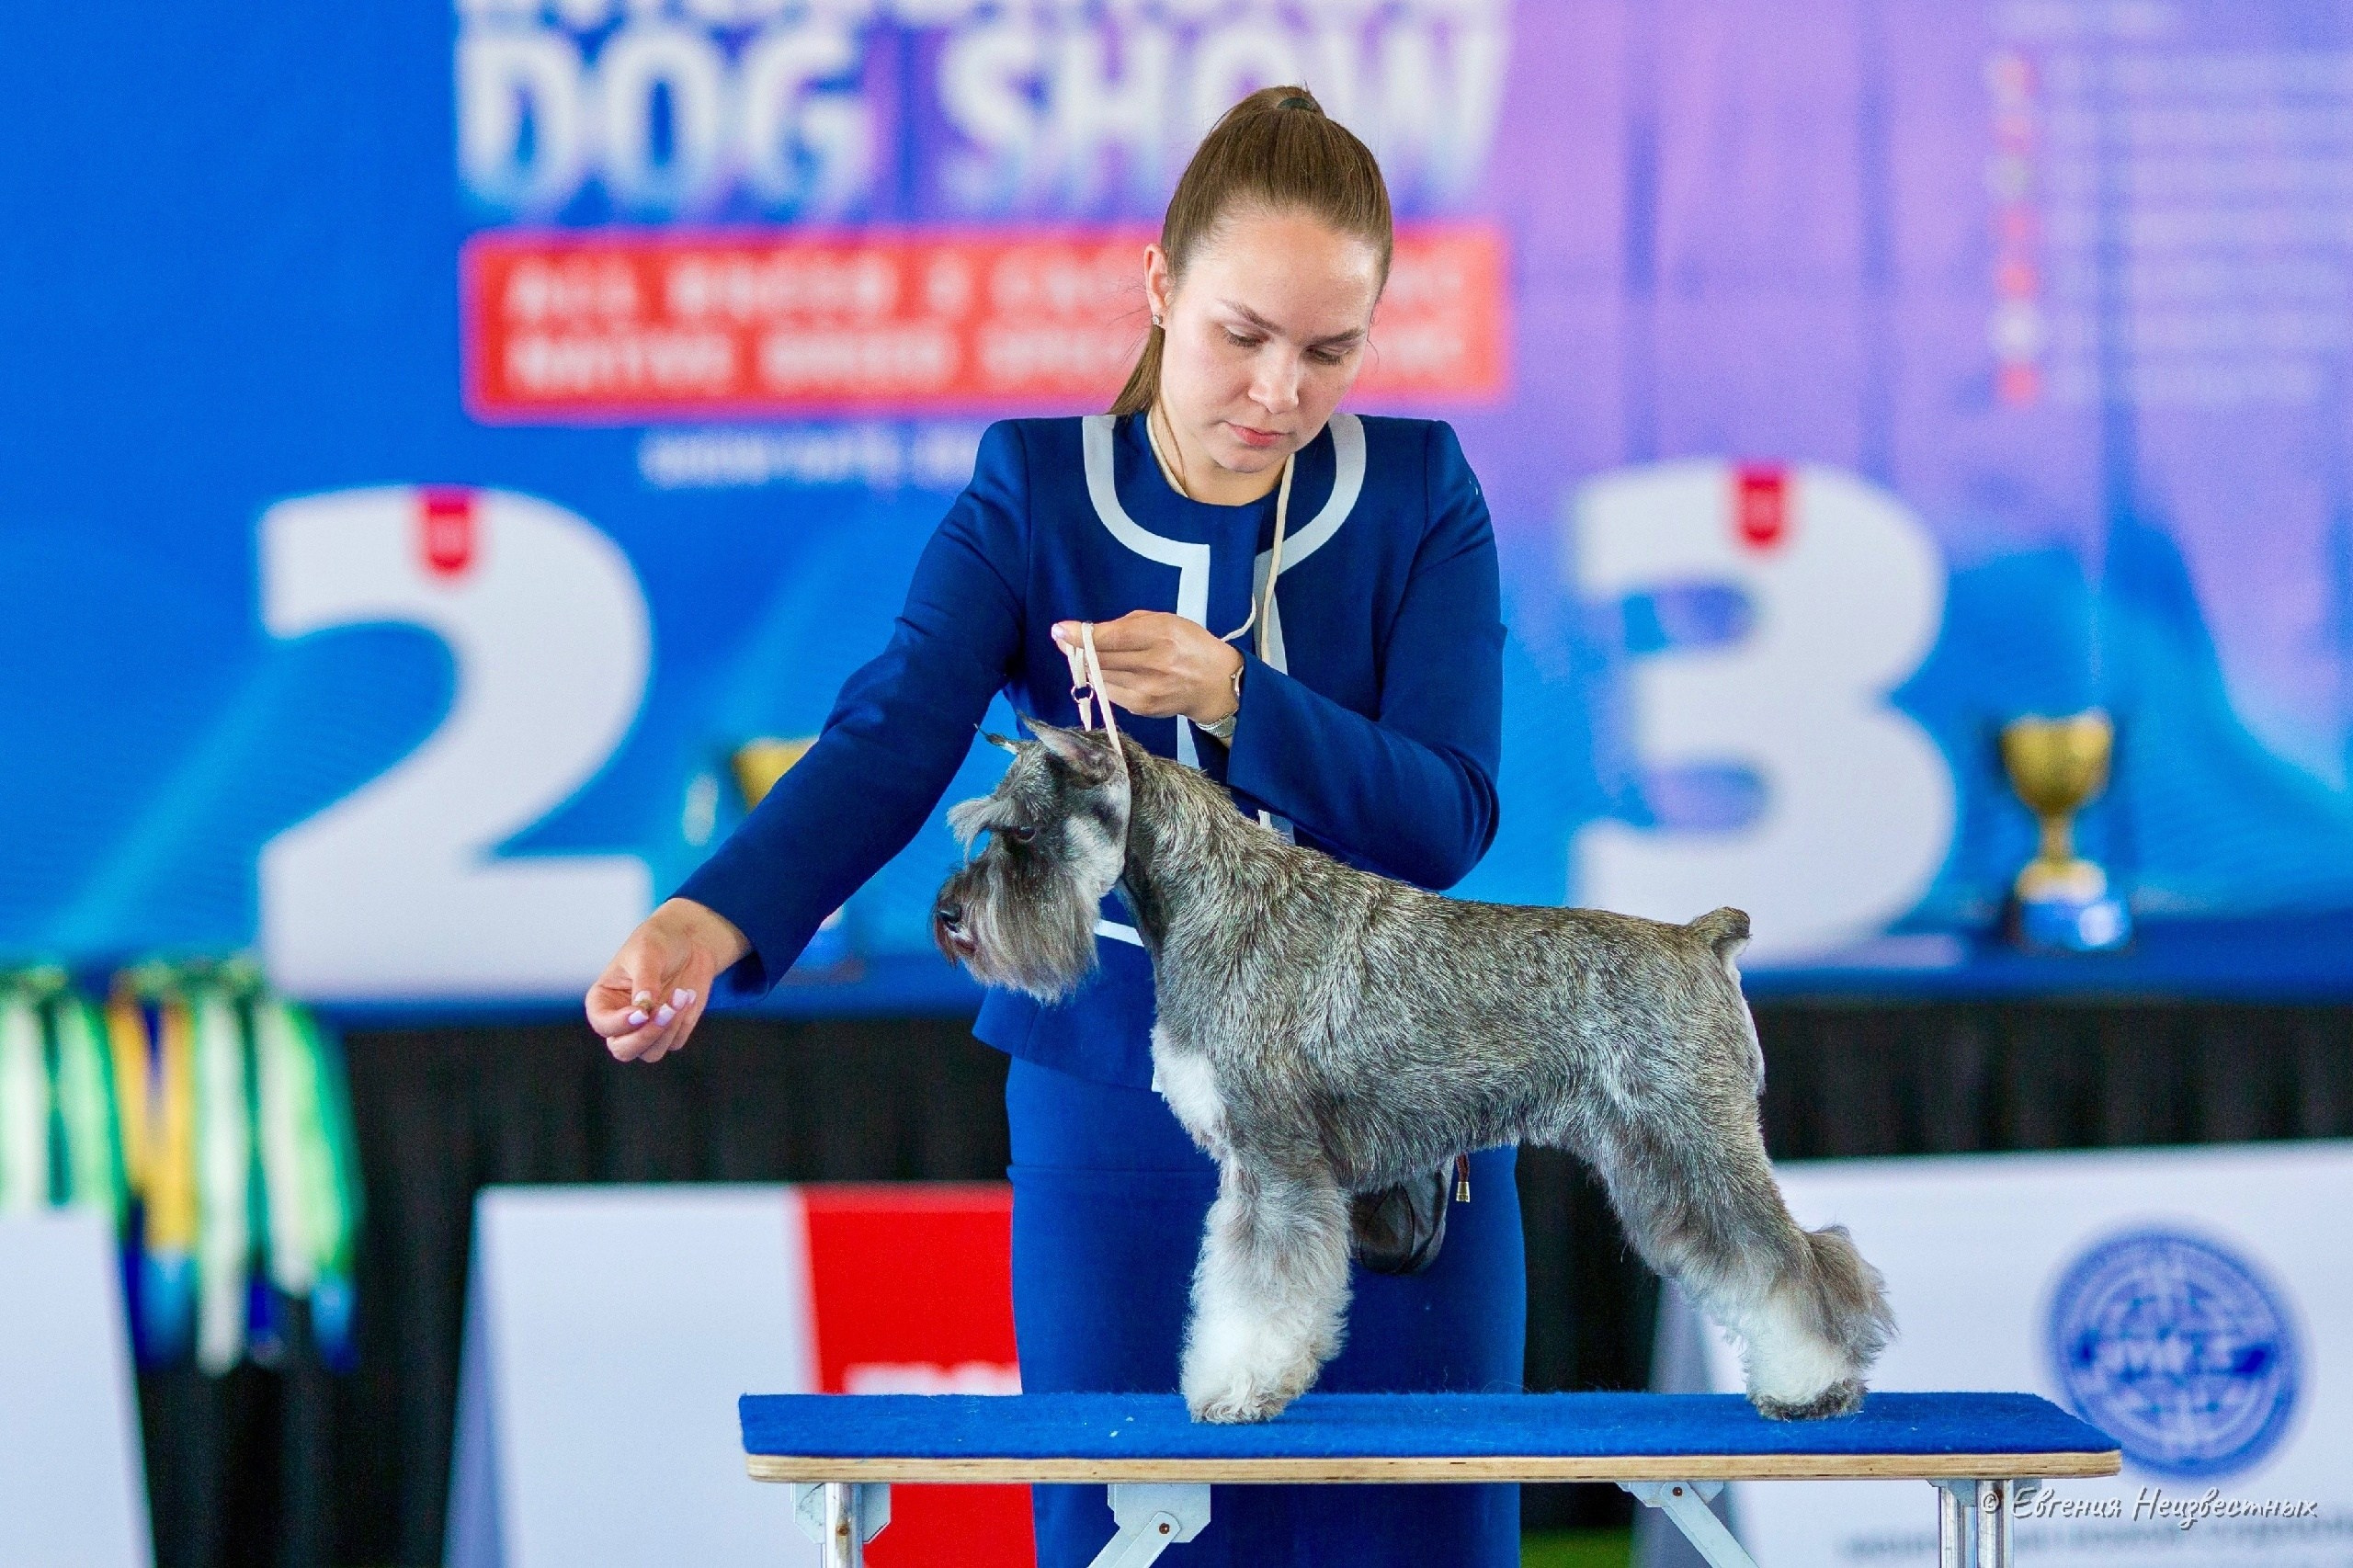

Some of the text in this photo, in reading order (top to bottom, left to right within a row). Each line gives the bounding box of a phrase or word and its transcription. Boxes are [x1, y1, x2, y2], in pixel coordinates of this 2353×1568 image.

[460, 26, 868, 213] DOG
[261, 487, 651, 998] 2
[1577, 462, 1954, 961] 3
